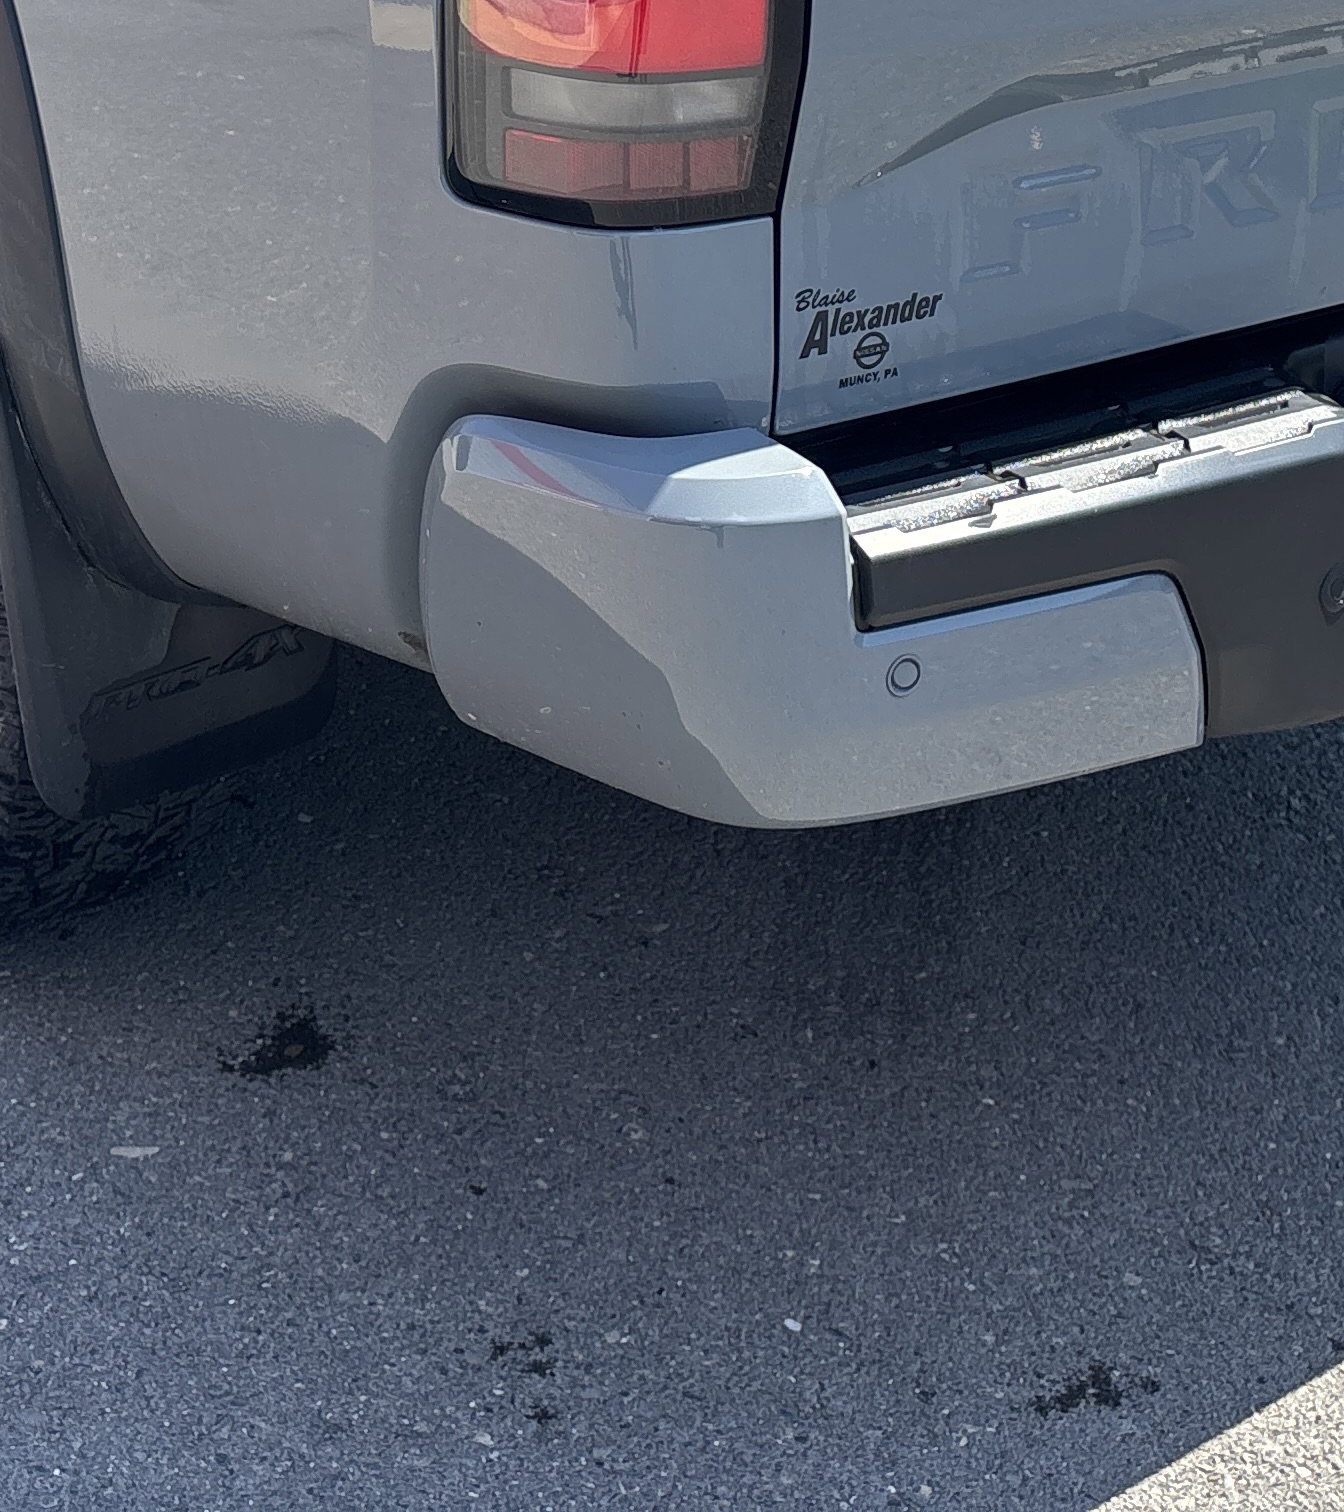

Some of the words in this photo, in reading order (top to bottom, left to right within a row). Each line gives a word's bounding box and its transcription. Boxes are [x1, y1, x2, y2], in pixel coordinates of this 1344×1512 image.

[795, 288, 857, 312] Blaise
[799, 292, 943, 359] Alexander
[839, 371, 881, 388] MUNCY,
[884, 367, 898, 380] PA
